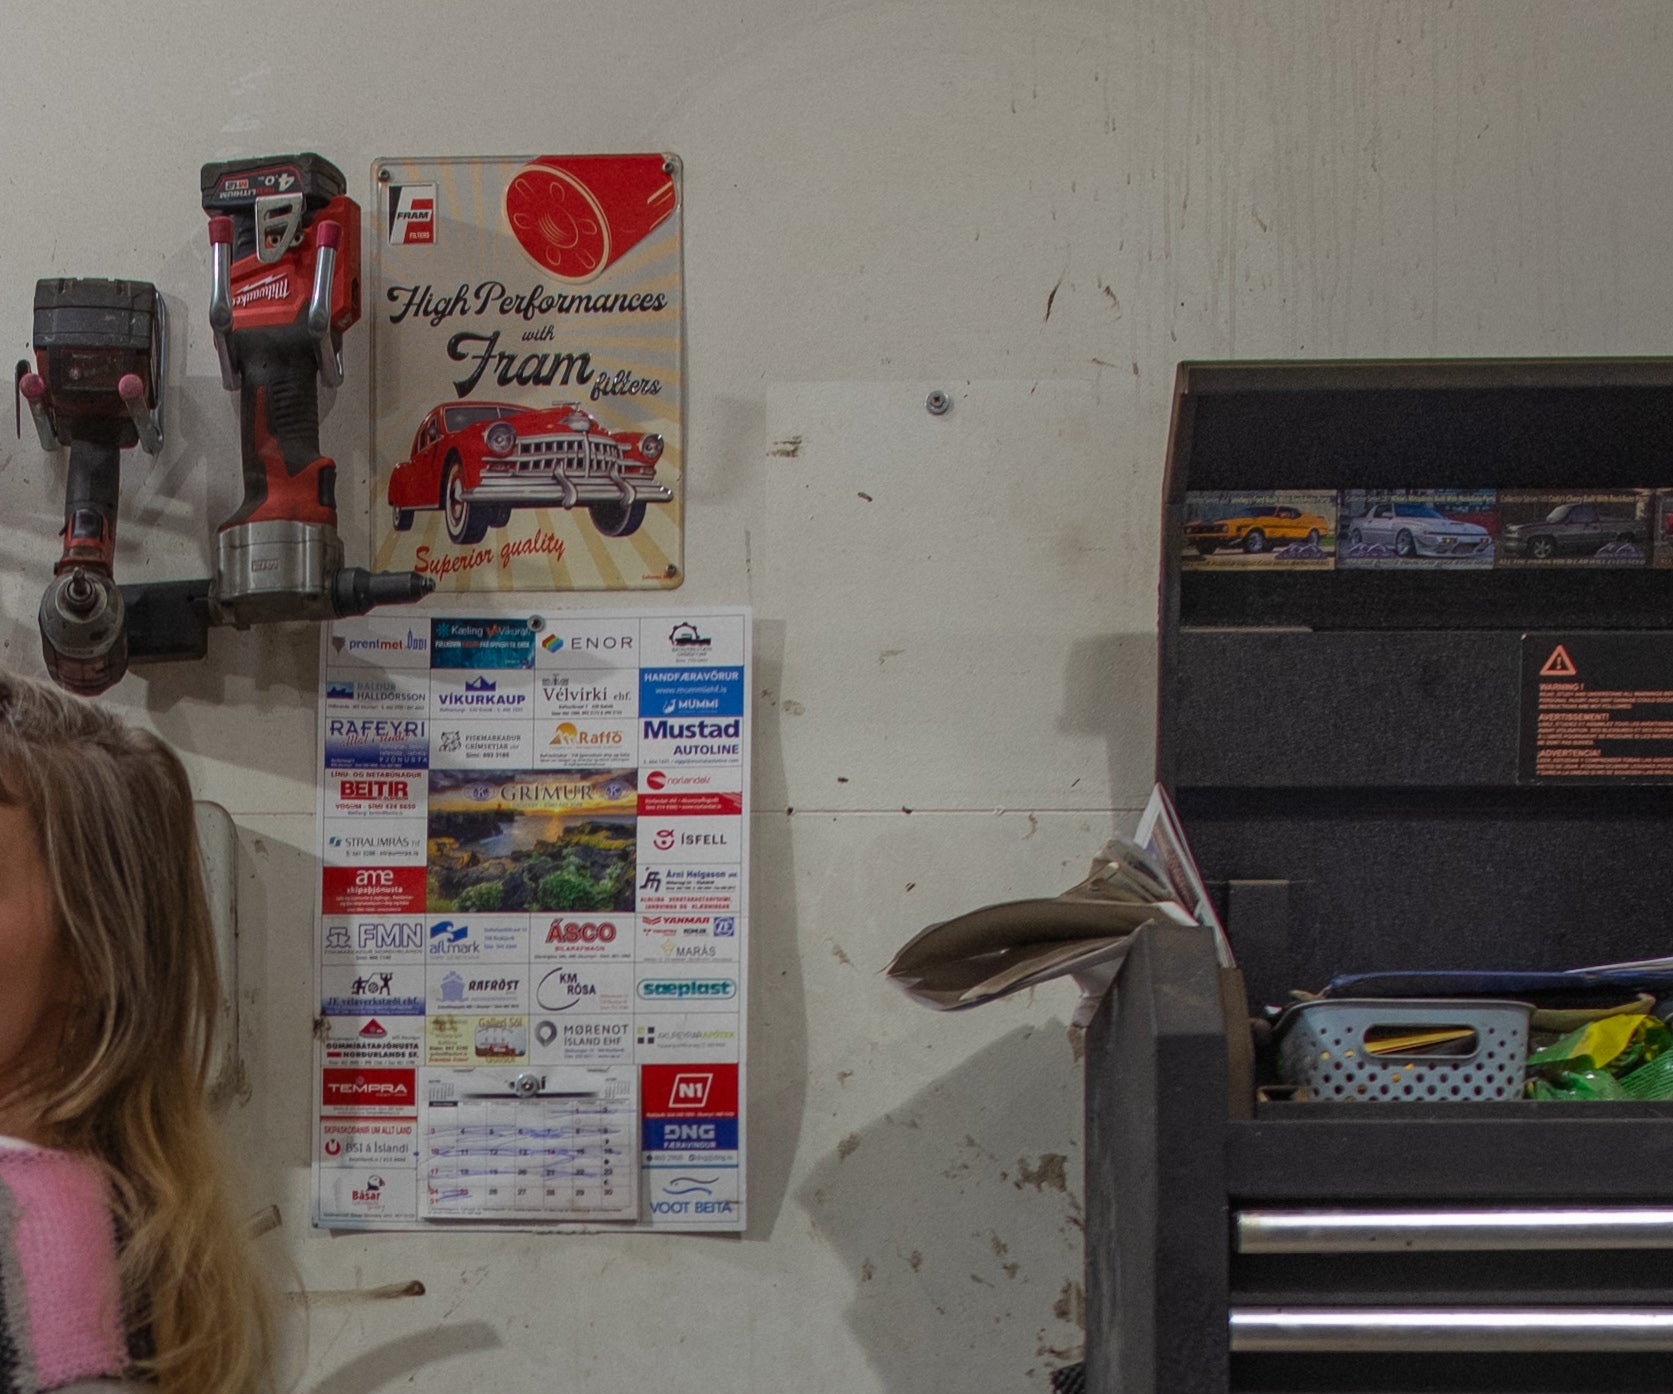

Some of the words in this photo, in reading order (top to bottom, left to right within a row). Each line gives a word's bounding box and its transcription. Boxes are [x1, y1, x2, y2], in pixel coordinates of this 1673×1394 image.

[397, 211, 429, 220] FRAM
[387, 284, 471, 327] High
[474, 281, 667, 322] Performances
[522, 325, 555, 342] with
[447, 331, 594, 398] Fram
[590, 370, 661, 401] filters
[414, 546, 494, 582] Superior
[500, 529, 566, 568] quality
[571, 636, 633, 649] ENOR
[644, 671, 738, 682] HANDFÆRAVÖRUR
[357, 691, 425, 701] HALLDÓRSSON
[439, 693, 525, 705] VÍKURKAUP
[544, 687, 607, 701] Vélvirki
[678, 699, 718, 709] MUMMI
[330, 720, 425, 736] RAFEYRI
[643, 720, 739, 739] Mustad
[674, 745, 738, 755] AUTOLINE
[1538, 749, 1601, 757] ADVERTENCIA!
[340, 781, 408, 796] BEITIR
[501, 782, 592, 802] GRÍMUR
[681, 833, 727, 845] ÍSFELL
[356, 870, 394, 885] ame
[358, 924, 423, 948] FMN
[545, 919, 616, 944] ÁSCO
[430, 942, 479, 954] aflmark
[676, 945, 716, 957] MARÁS
[560, 973, 577, 984] KM
[567, 984, 596, 995] RÓSA
[564, 1024, 628, 1035] MØRENOT
[564, 1035, 600, 1046] ÍSLAND
[603, 1037, 621, 1046] EHF
[327, 1083, 407, 1093] TEMPRA
[679, 1083, 703, 1098] N1
[664, 1125, 715, 1139] DNG
[374, 1140, 408, 1152] Íslandi
[352, 1191, 380, 1200] Básar
[650, 1201, 688, 1214] VOOT
[695, 1201, 732, 1213] BEITA
